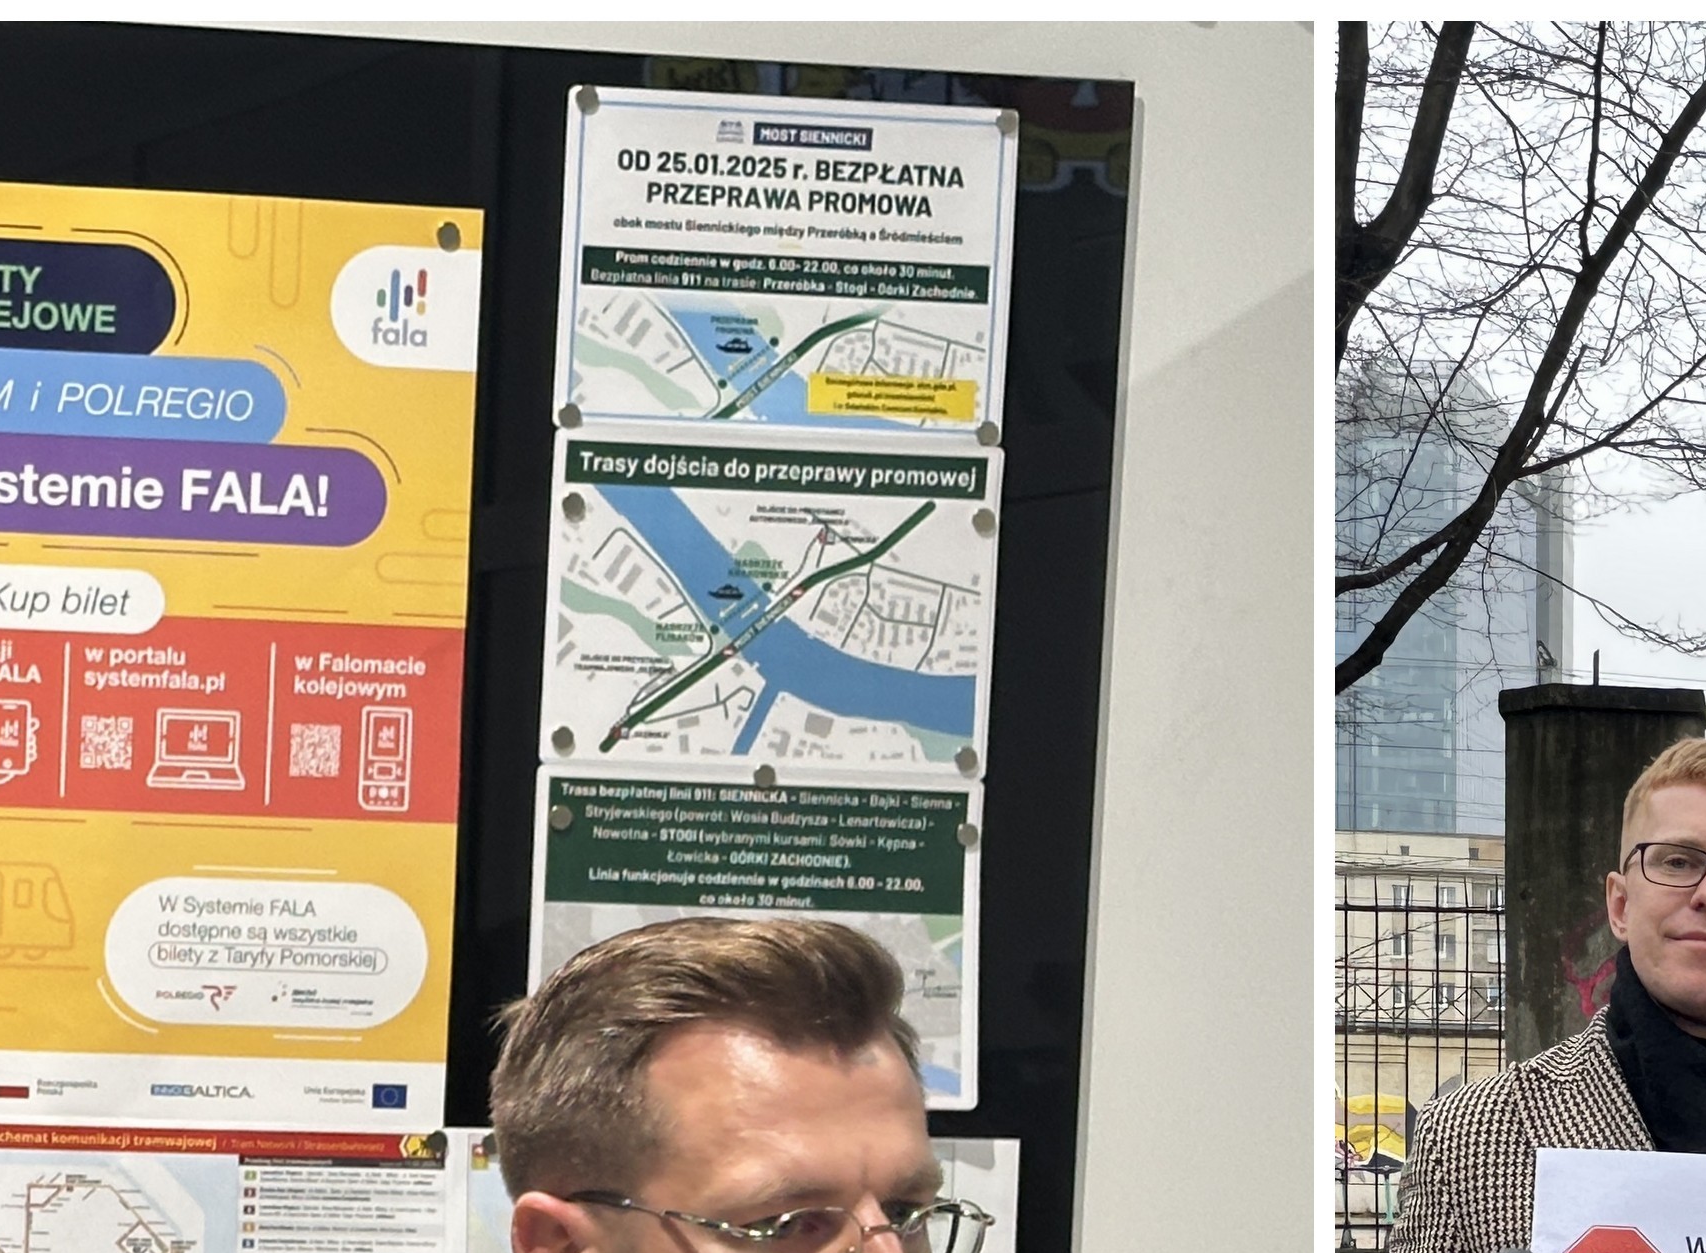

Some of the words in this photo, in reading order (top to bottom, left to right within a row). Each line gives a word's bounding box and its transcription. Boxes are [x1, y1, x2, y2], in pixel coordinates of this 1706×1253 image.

[760, 127, 797, 143] MOST
[800, 131, 867, 146] SIENNICKI
[618, 149, 650, 172] OD
[657, 152, 786, 178] 25.01.2025
[792, 162, 808, 180] r.
[815, 161, 964, 189] BEZPŁATNA
[647, 182, 801, 211] PRZEPRAWA
[809, 191, 932, 218] PROMOWA
[613, 216, 642, 228] obok
[645, 220, 682, 230] mostu
[685, 220, 761, 236] Siennickiego
[763, 224, 805, 239] między
[615, 251, 649, 264] Prom
[651, 253, 717, 268] codziennie
[720, 258, 731, 268] w
[844, 263, 858, 275] co
[861, 262, 896, 276] około
[899, 264, 915, 278] 30
[591, 268, 652, 283] Bezpłatna
[654, 271, 679, 284] linia
[681, 272, 702, 285] 911
[704, 276, 719, 287] na
[763, 276, 825, 292] Przeróbka
[835, 281, 867, 296] Stogi
[372, 316, 428, 348] fala
[30, 382, 42, 411] i
[58, 382, 254, 422] POLREGIO
[580, 452, 638, 477] Trasy
[644, 453, 720, 480] dojścia
[724, 458, 750, 480] do
[755, 463, 865, 488] przeprawy
[871, 466, 978, 492] promowej
[181, 471, 329, 517] FALA!
[61, 585, 131, 617] bilet
[85, 649, 104, 663] w
[110, 644, 186, 672] portalu
[294, 658, 312, 670] w
[319, 653, 426, 676] Falomacie
[84, 667, 225, 692] systemfala.pl
[293, 675, 407, 699] kolejowym
[561, 783, 597, 797] Trasa
[599, 785, 667, 802] bezpłatnej
[669, 787, 692, 800] linii
[719, 789, 787, 804] SIENNICKA
[799, 792, 859, 807] Siennicka
[585, 804, 672, 823] Stryjewskiego
[593, 826, 648, 841] Nowotna
[660, 828, 697, 842] STOGI
[667, 849, 719, 864] Łowicka
[730, 851, 768, 865] GÓRKI
[589, 867, 620, 881] Linia
[622, 868, 695, 886] funkcjonuje
[698, 871, 765, 886] codziennie
[768, 876, 779, 887] w
[781, 874, 844, 889] godzinach
[159, 895, 178, 913] W
[183, 896, 264, 918] Systemie
[270, 899, 316, 917] FALA
[699, 895, 715, 905] co
[757, 894, 773, 907] 30
[158, 920, 242, 943] dostępne
[247, 926, 267, 944] są
[273, 928, 357, 946] wszystkie
[157, 946, 203, 965] bilety
[208, 951, 218, 963] z
[225, 947, 275, 968] Taryfy
[280, 949, 377, 972] Pomorskiej
[51, 1132, 130, 1150] komunikacji
[133, 1135, 217, 1151] tramwajowej
